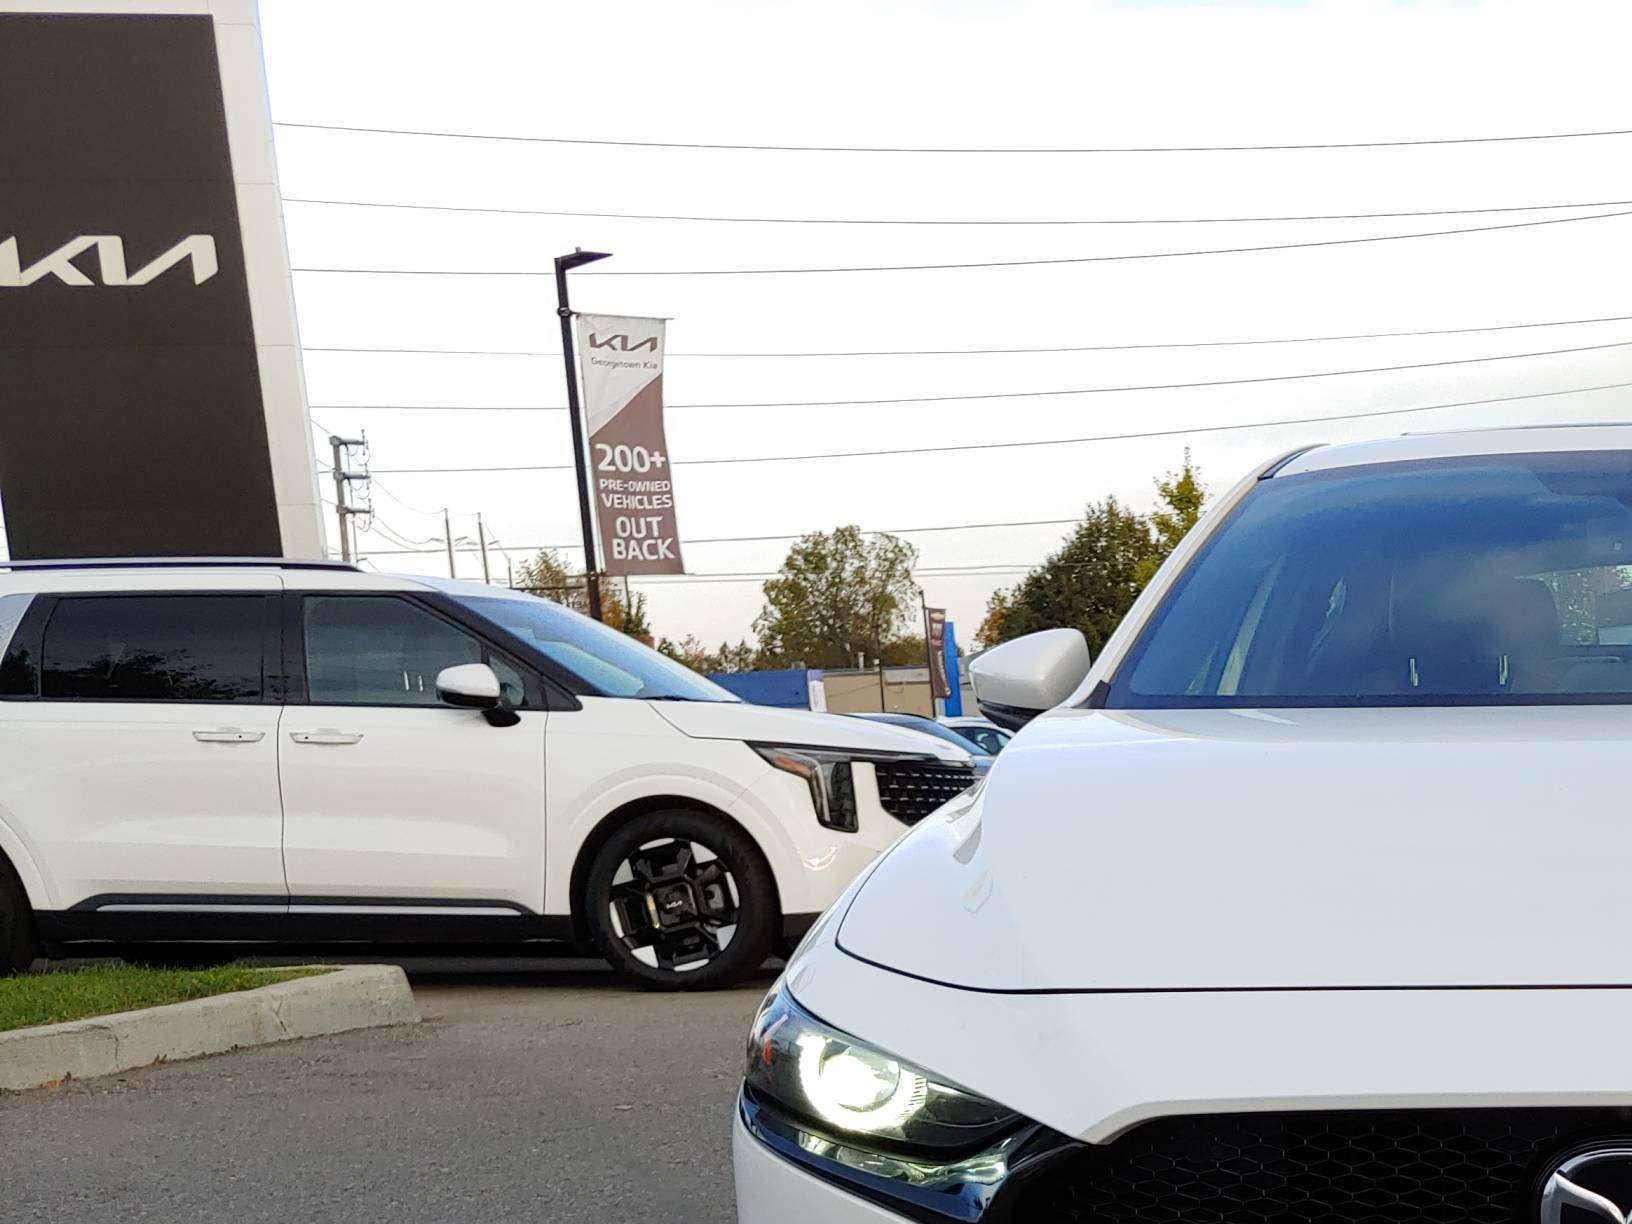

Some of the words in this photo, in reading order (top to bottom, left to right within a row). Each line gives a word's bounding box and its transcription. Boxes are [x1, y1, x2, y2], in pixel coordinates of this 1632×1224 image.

[0, 234, 219, 287] KIA
[589, 332, 658, 352] KIA
[595, 443, 666, 473] 200+
[599, 478, 671, 492] PRE-OWNED
[601, 493, 673, 510] VEHICLES
[616, 516, 662, 539] OUT
[612, 538, 675, 561] BACK
